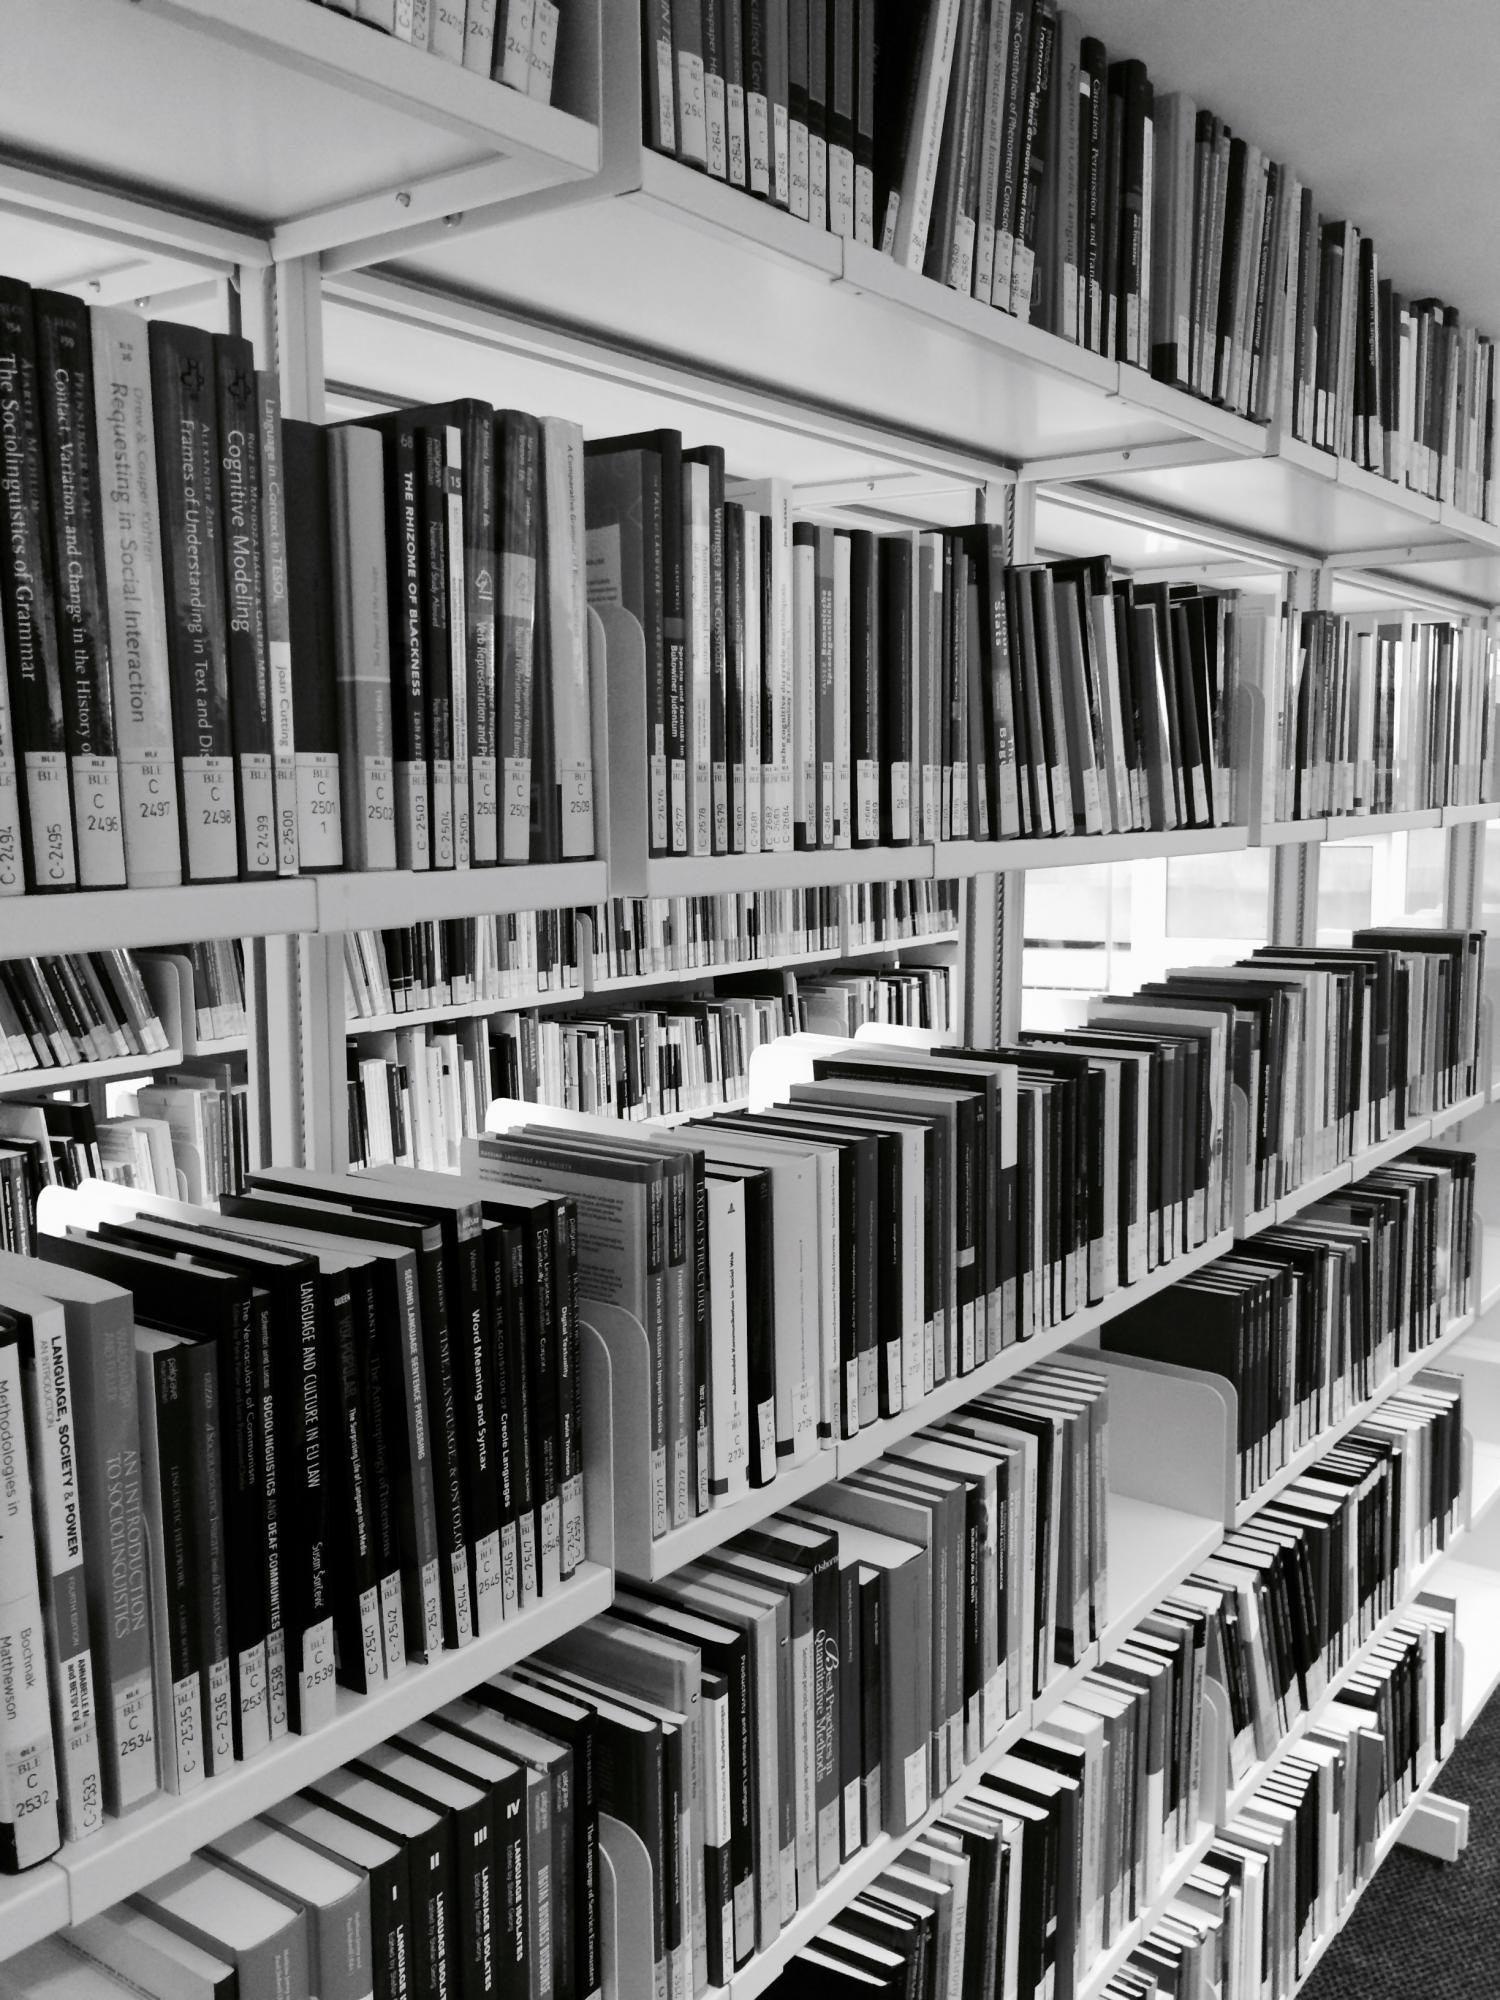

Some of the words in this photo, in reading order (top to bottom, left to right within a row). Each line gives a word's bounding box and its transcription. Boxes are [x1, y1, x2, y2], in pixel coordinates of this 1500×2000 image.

[1014, 10, 1025, 32] The
[1010, 33, 1023, 100] Constitution
[1005, 115, 1018, 184] Phenomenal
[0, 353, 20, 396] The
[109, 382, 131, 504] Requesting
[181, 419, 195, 483] Frames
[263, 398, 279, 460] Language
[1, 400, 27, 554] Sociolinguistics
[222, 429, 247, 527] Cognitive
[402, 471, 415, 508] THE
[449, 475, 463, 489] 15
[119, 512, 136, 532] in
[268, 481, 283, 536] Context
[64, 525, 82, 556] and
[404, 509, 419, 575] RHIZOME
[711, 507, 723, 567] Writing(s)
[14, 559, 33, 581] of
[65, 559, 83, 622] Change
[120, 540, 142, 602] Social
[184, 508, 204, 634] Understanding
[230, 535, 251, 633] Modeling
[270, 556, 287, 603] TESOL
[406, 577, 419, 605] OF
[15, 585, 36, 682] Grammar
[407, 607, 422, 698] BLACKNESS
[713, 606, 725, 675] Crossroads
[73, 649, 87, 674] the
[123, 608, 145, 723] Interaction
[190, 660, 209, 690] Text
[274, 665, 288, 694] Joan
[475, 646, 488, 722] Representation
[670, 644, 679, 694] Bukowiner
[74, 680, 92, 737] History
[196, 700, 211, 729] and
[278, 699, 290, 749] Cutting
[670, 695, 680, 738] Judentum
[92, 793, 105, 810] C
[139, 801, 171, 818] 2497
[148, 779, 160, 795] C
[209, 786, 221, 802] C
[311, 800, 337, 816] 2501
[317, 781, 327, 797] C
[203, 809, 232, 826] 2498
[299, 1280, 316, 1343] LANGUAGE
[404, 1268, 415, 1305] SECOND
[406, 1306, 419, 1355] LANGUAGE
[471, 1309, 483, 1345] Word
[50, 1335, 69, 1422] LANGUAGE,
[302, 1346, 317, 1371] AND
[410, 1355, 423, 1403] SENTENCE
[473, 1346, 486, 1402] Meaning
[303, 1373, 319, 1425] CULTURE
[476, 1402, 487, 1427] and
[57, 1423, 75, 1487] SOCIETY
[262, 1394, 277, 1497] SOCIOLINGUISTICS
[306, 1443, 320, 1462] EU
[413, 1403, 426, 1461] PROCESSING
[476, 1428, 489, 1471] Syntax
[500, 1412, 510, 1448] Creole
[105, 1454, 123, 1480] TO
[122, 1450, 138, 1476] AN
[307, 1463, 321, 1488] LAW
[501, 1449, 513, 1508] Languages
[6, 1500, 20, 1517] in
[64, 1503, 79, 1558] POWER
[107, 1483, 131, 1639] SOCIOLINGUISTICS
[124, 1482, 146, 1633] INTRODUCTION
[267, 1522, 279, 1551] DEAF
[312, 1541, 324, 1571] Susan
[268, 1552, 282, 1630] COMMUNITIES
[0, 1635, 18, 1721] Matthewson
[20, 1626, 36, 1690] Bochnak
[306, 1662, 335, 1689] 2539
[814, 1629, 826, 1716] Quantitative
[825, 1637, 840, 1694] Best
[69, 1681, 80, 1709] BETSY
[77, 1658, 91, 1709] ANNABELLE
[128, 1715, 139, 1730] C
[824, 1693, 837, 1759] Practices
[815, 1715, 829, 1783] Methods
[15, 1790, 50, 1818] 2532
[27, 1774, 38, 1789] C
[506, 1798, 521, 1821] IV
[473, 1825, 488, 1848] III
[513, 1838, 523, 1904] LANGUAGE
[481, 1866, 491, 1933] LANGUAGE
[515, 1904, 525, 1962] ISOLATES
[483, 1933, 493, 1992] ISOLATES
